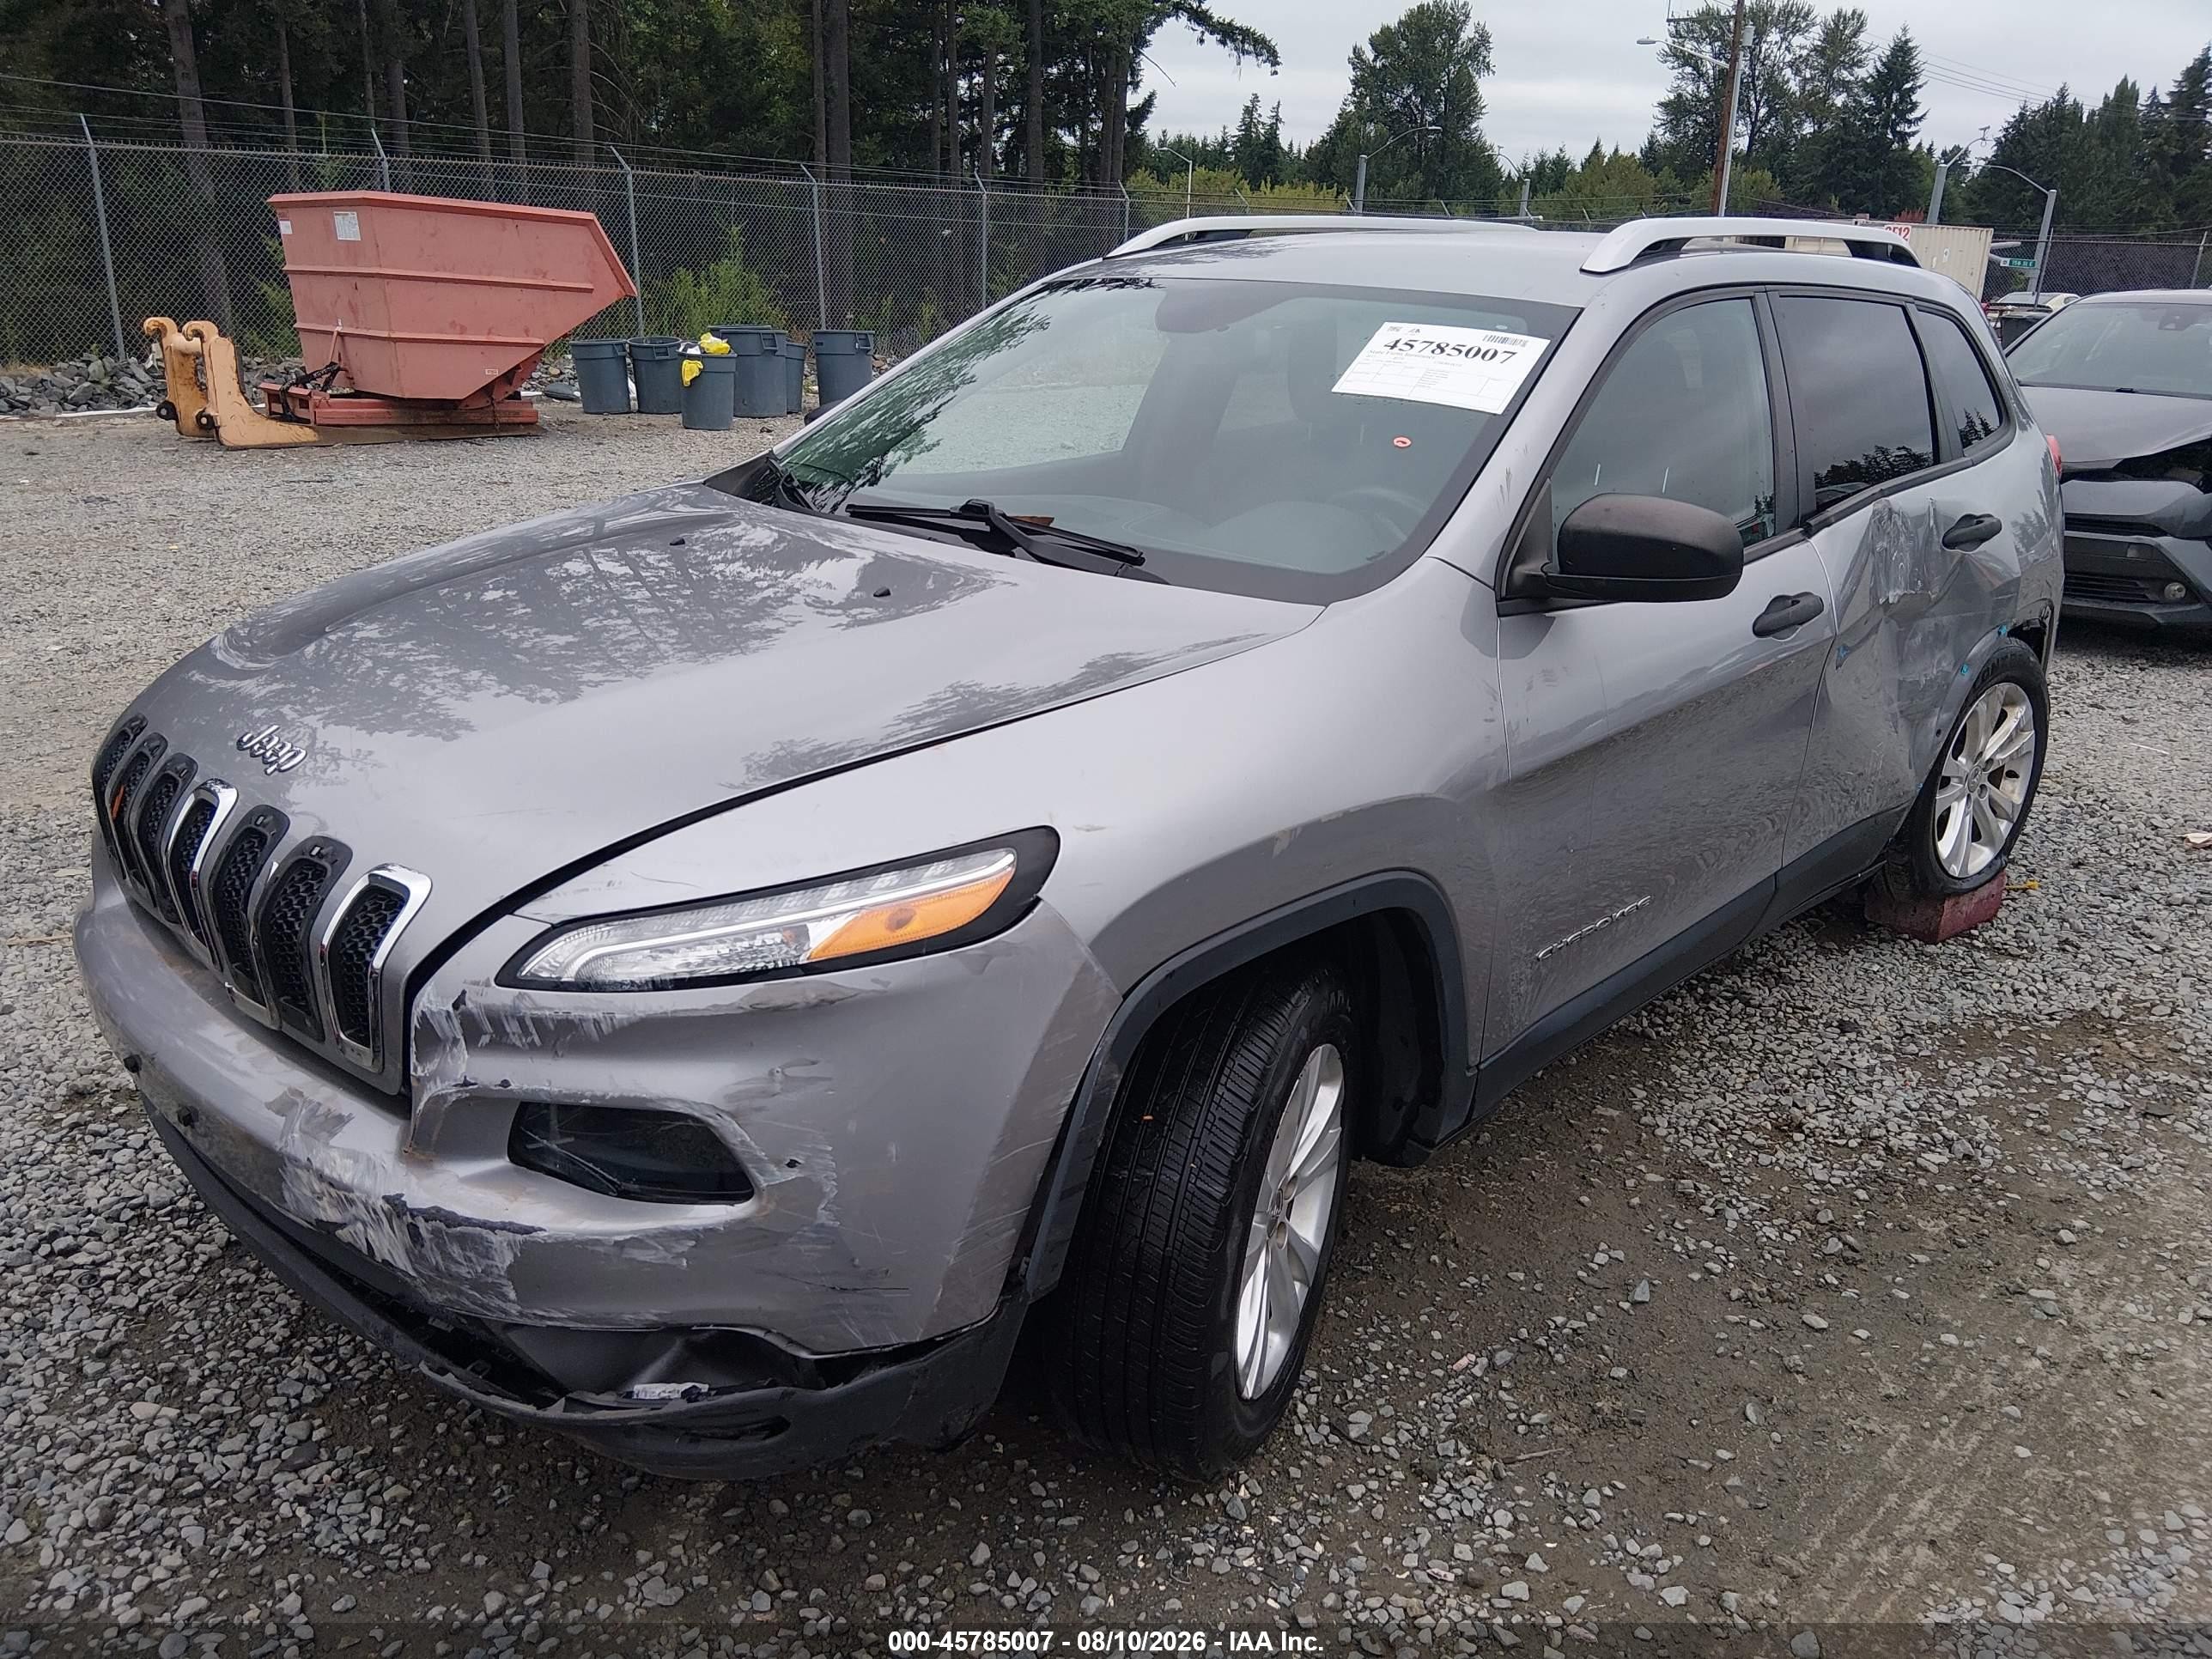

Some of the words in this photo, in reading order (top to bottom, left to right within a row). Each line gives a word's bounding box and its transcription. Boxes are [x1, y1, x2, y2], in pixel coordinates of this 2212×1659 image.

[1885, 227, 1910, 241] 12
[1383, 338, 1517, 364] 45785007
[237, 725, 307, 775] Jeep
[1536, 896, 1651, 959] CHEROKEE
